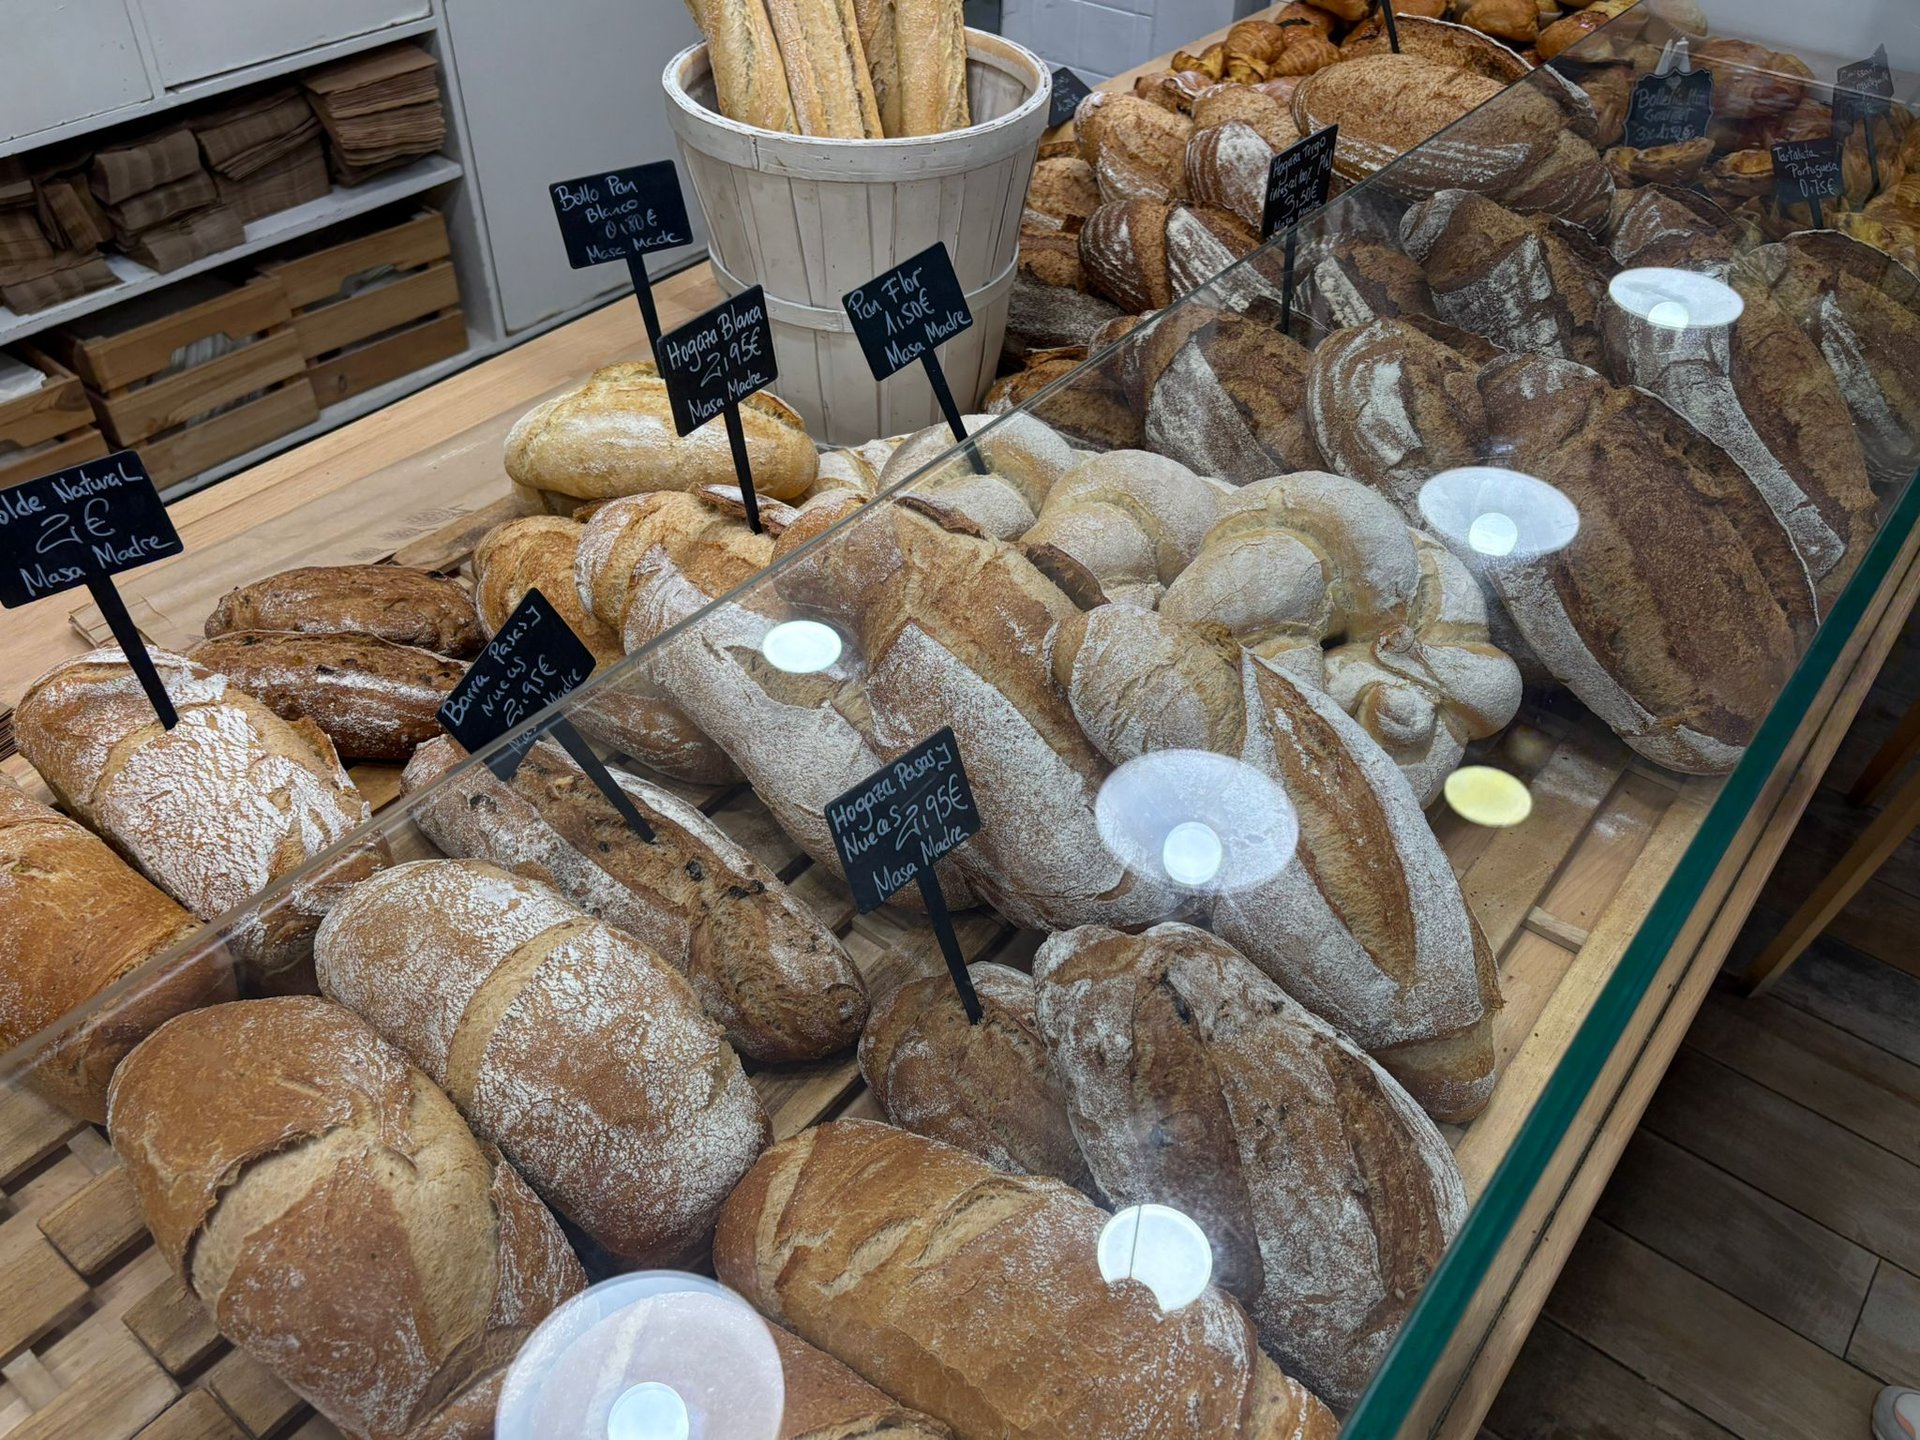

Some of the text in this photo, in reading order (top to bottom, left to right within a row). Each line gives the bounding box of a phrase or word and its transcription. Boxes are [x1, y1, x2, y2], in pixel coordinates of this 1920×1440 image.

[1302, 136, 1326, 160] Trigo
[554, 175, 639, 212] Bollo Pan
[585, 199, 639, 224] Blanco
[585, 244, 627, 264] Masa
[848, 267, 923, 321] Pan Flor
[666, 304, 763, 373] Hogaza Blanca
[700, 326, 762, 388] 2,95€
[884, 310, 972, 371] Masa Madre
[687, 369, 769, 425] Masa Madre
[0, 490, 46, 525] olde
[19, 534, 175, 597] Masa Madre
[441, 673, 490, 727] Barra
[488, 619, 528, 665] Pasas
[481, 656, 527, 718] Nueces
[543, 667, 583, 707] Madre
[831, 777, 897, 835] Hogaza
[893, 750, 936, 791] Pasas
[895, 772, 970, 851] 2,95€
[842, 804, 903, 864] Nueces
[872, 825, 971, 902] Masa Madre
